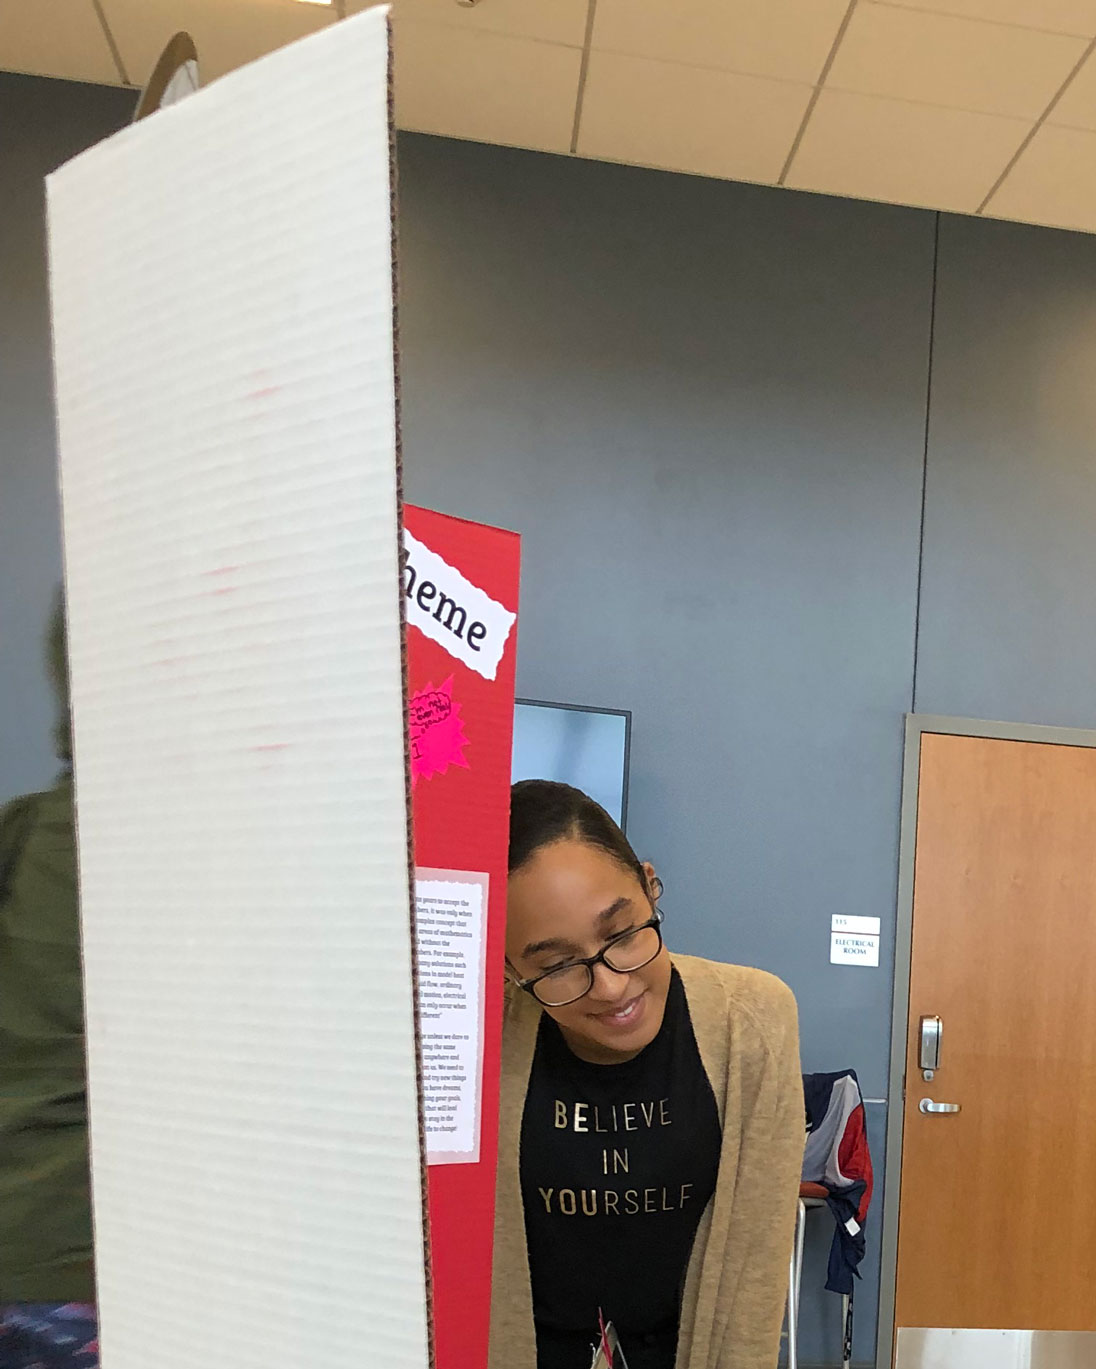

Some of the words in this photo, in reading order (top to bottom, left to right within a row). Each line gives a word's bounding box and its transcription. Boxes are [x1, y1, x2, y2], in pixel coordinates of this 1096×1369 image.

[835, 939, 875, 947] ELECTRICAL
[554, 1098, 672, 1133] BELIEVE
[603, 1148, 630, 1175] IN
[538, 1183, 693, 1216] YOURSELF
